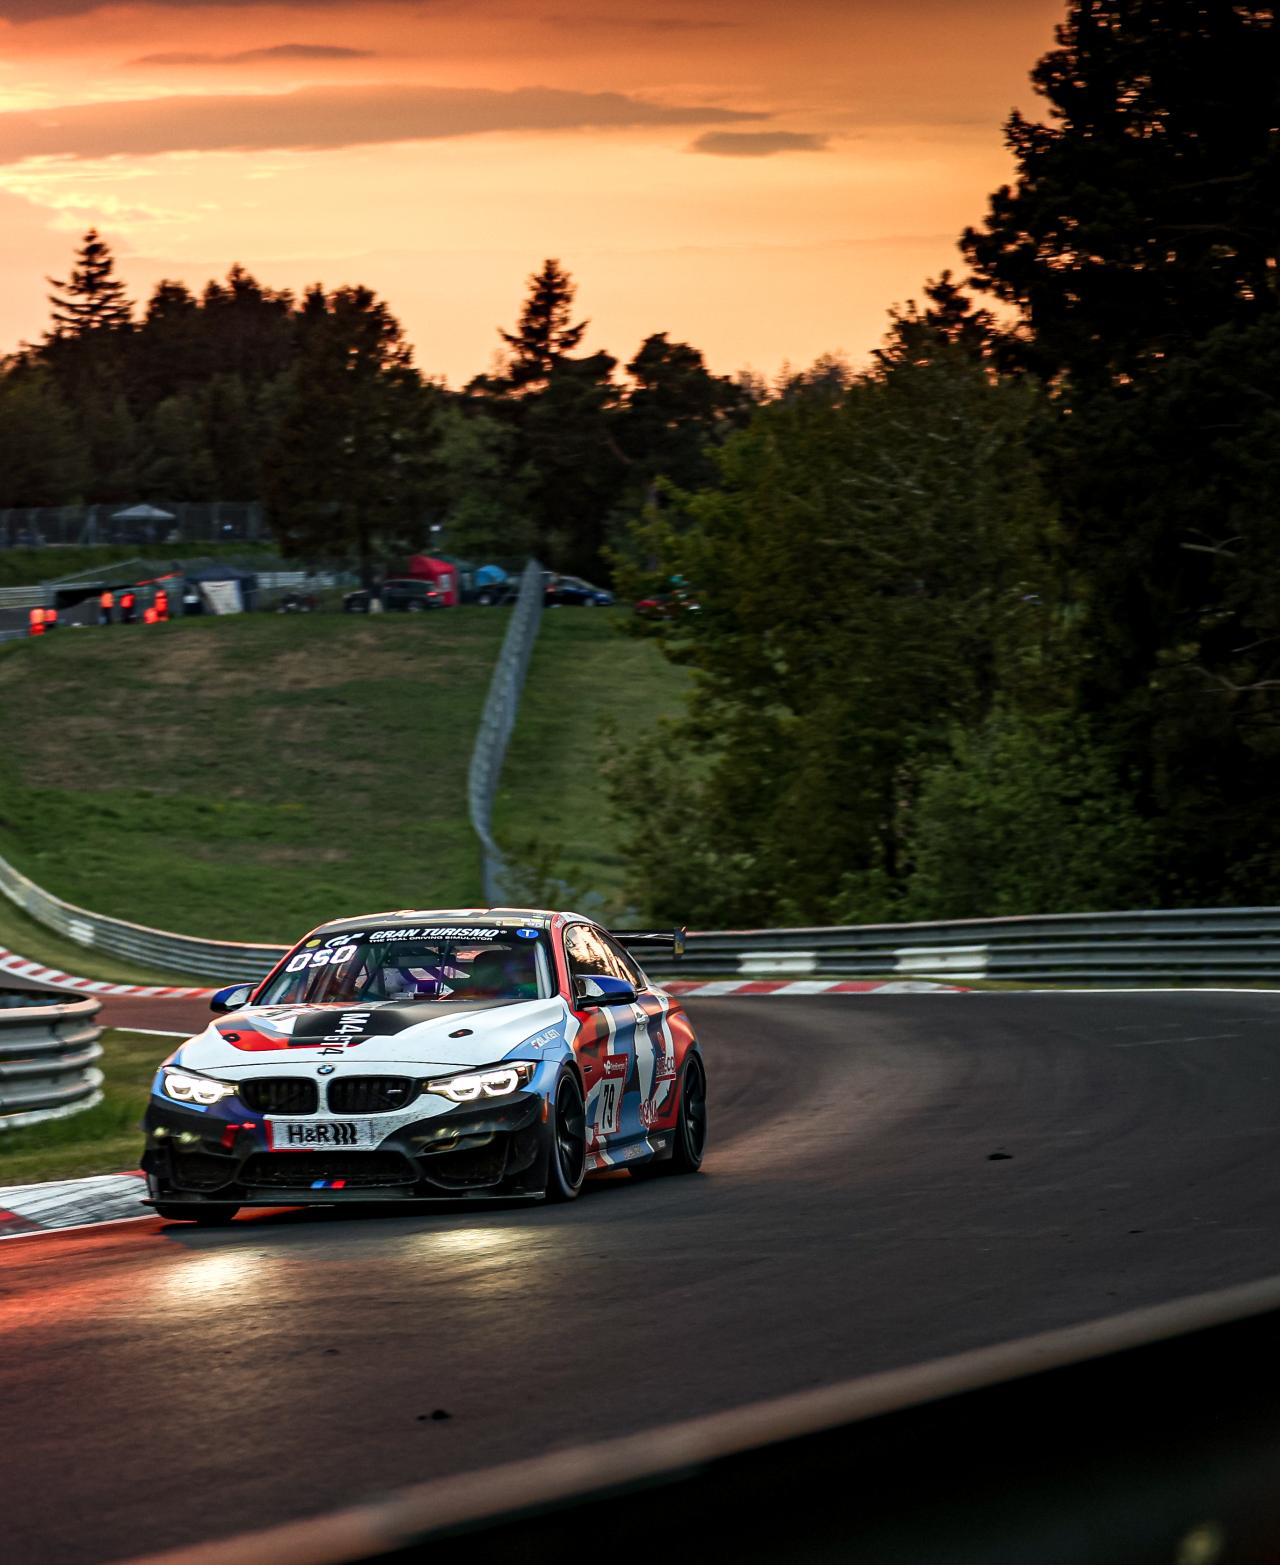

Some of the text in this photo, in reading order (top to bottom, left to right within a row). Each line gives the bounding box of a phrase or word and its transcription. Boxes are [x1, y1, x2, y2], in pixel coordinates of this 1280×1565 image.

[369, 928, 499, 939] GRAN TURISMO
[522, 929, 533, 937] T
[602, 1083, 615, 1129] 79
[287, 1122, 331, 1145] H&R
